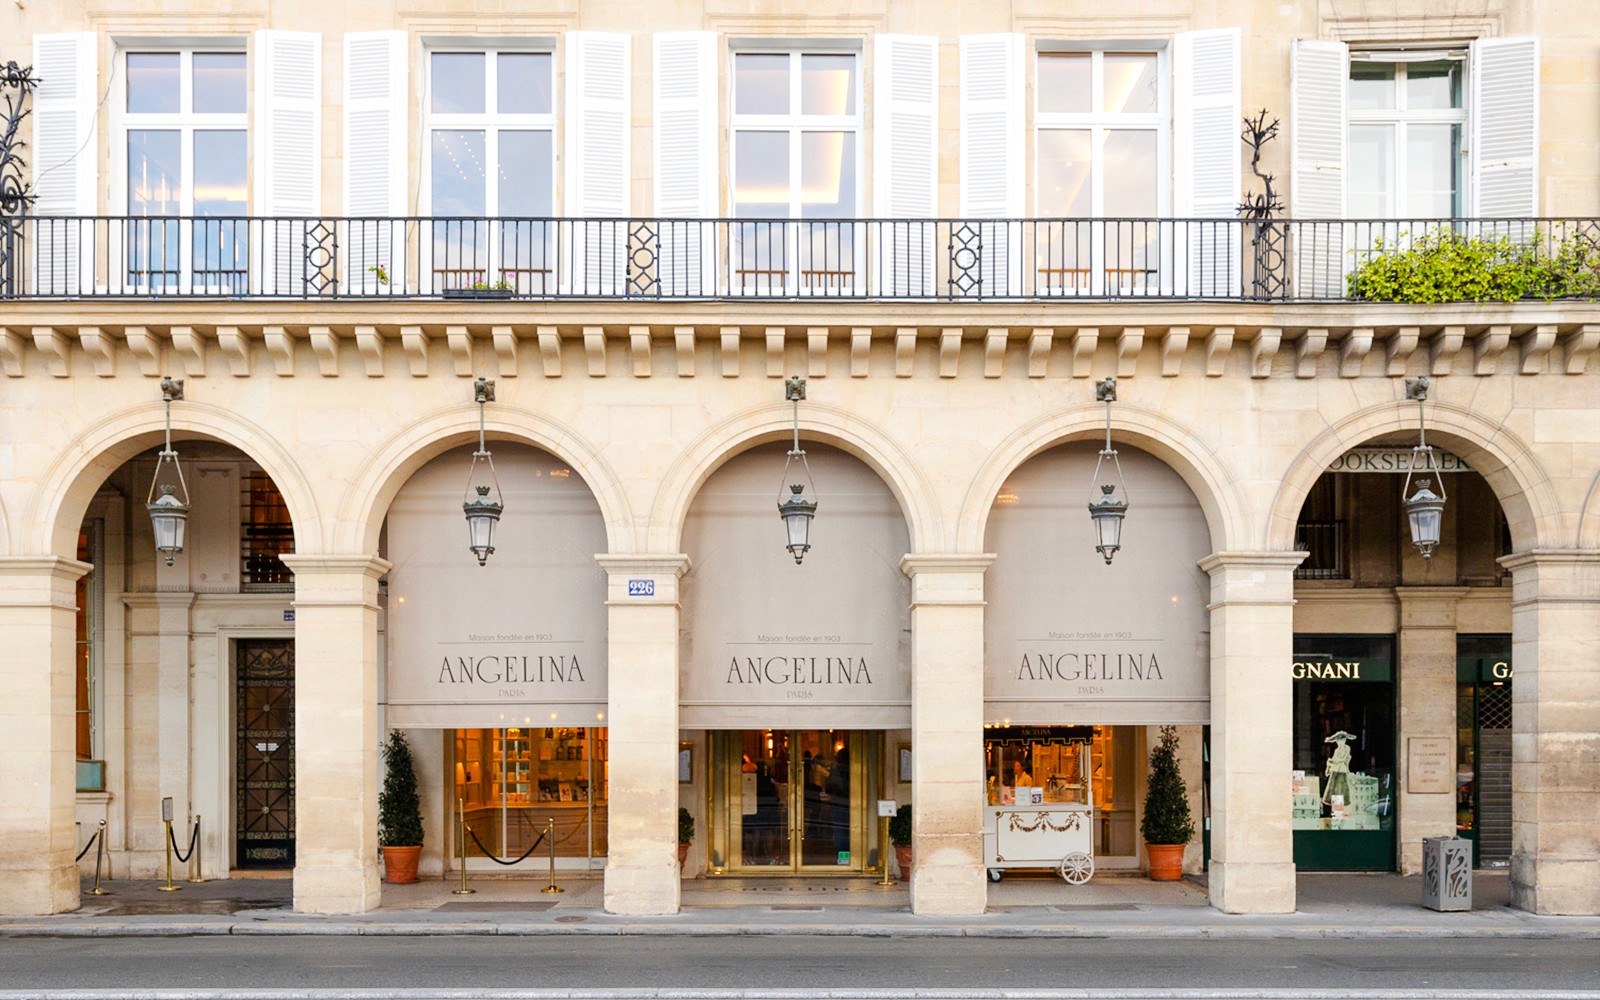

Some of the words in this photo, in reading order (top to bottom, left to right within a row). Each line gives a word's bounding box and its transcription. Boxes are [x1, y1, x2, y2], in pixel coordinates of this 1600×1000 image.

[630, 581, 653, 595] 226
[824, 635, 841, 643] 1903
[1048, 631, 1075, 639] Maison
[1076, 631, 1102, 639] fondée
[438, 654, 585, 684] ANGELINA
[726, 656, 873, 685] ANGELINA
[1017, 653, 1164, 681] ANGELINA
[1291, 662, 1360, 679] GNANI
[498, 689, 525, 697] PARIS
[786, 690, 813, 699] PARIS
[1078, 687, 1105, 695] PARIS
